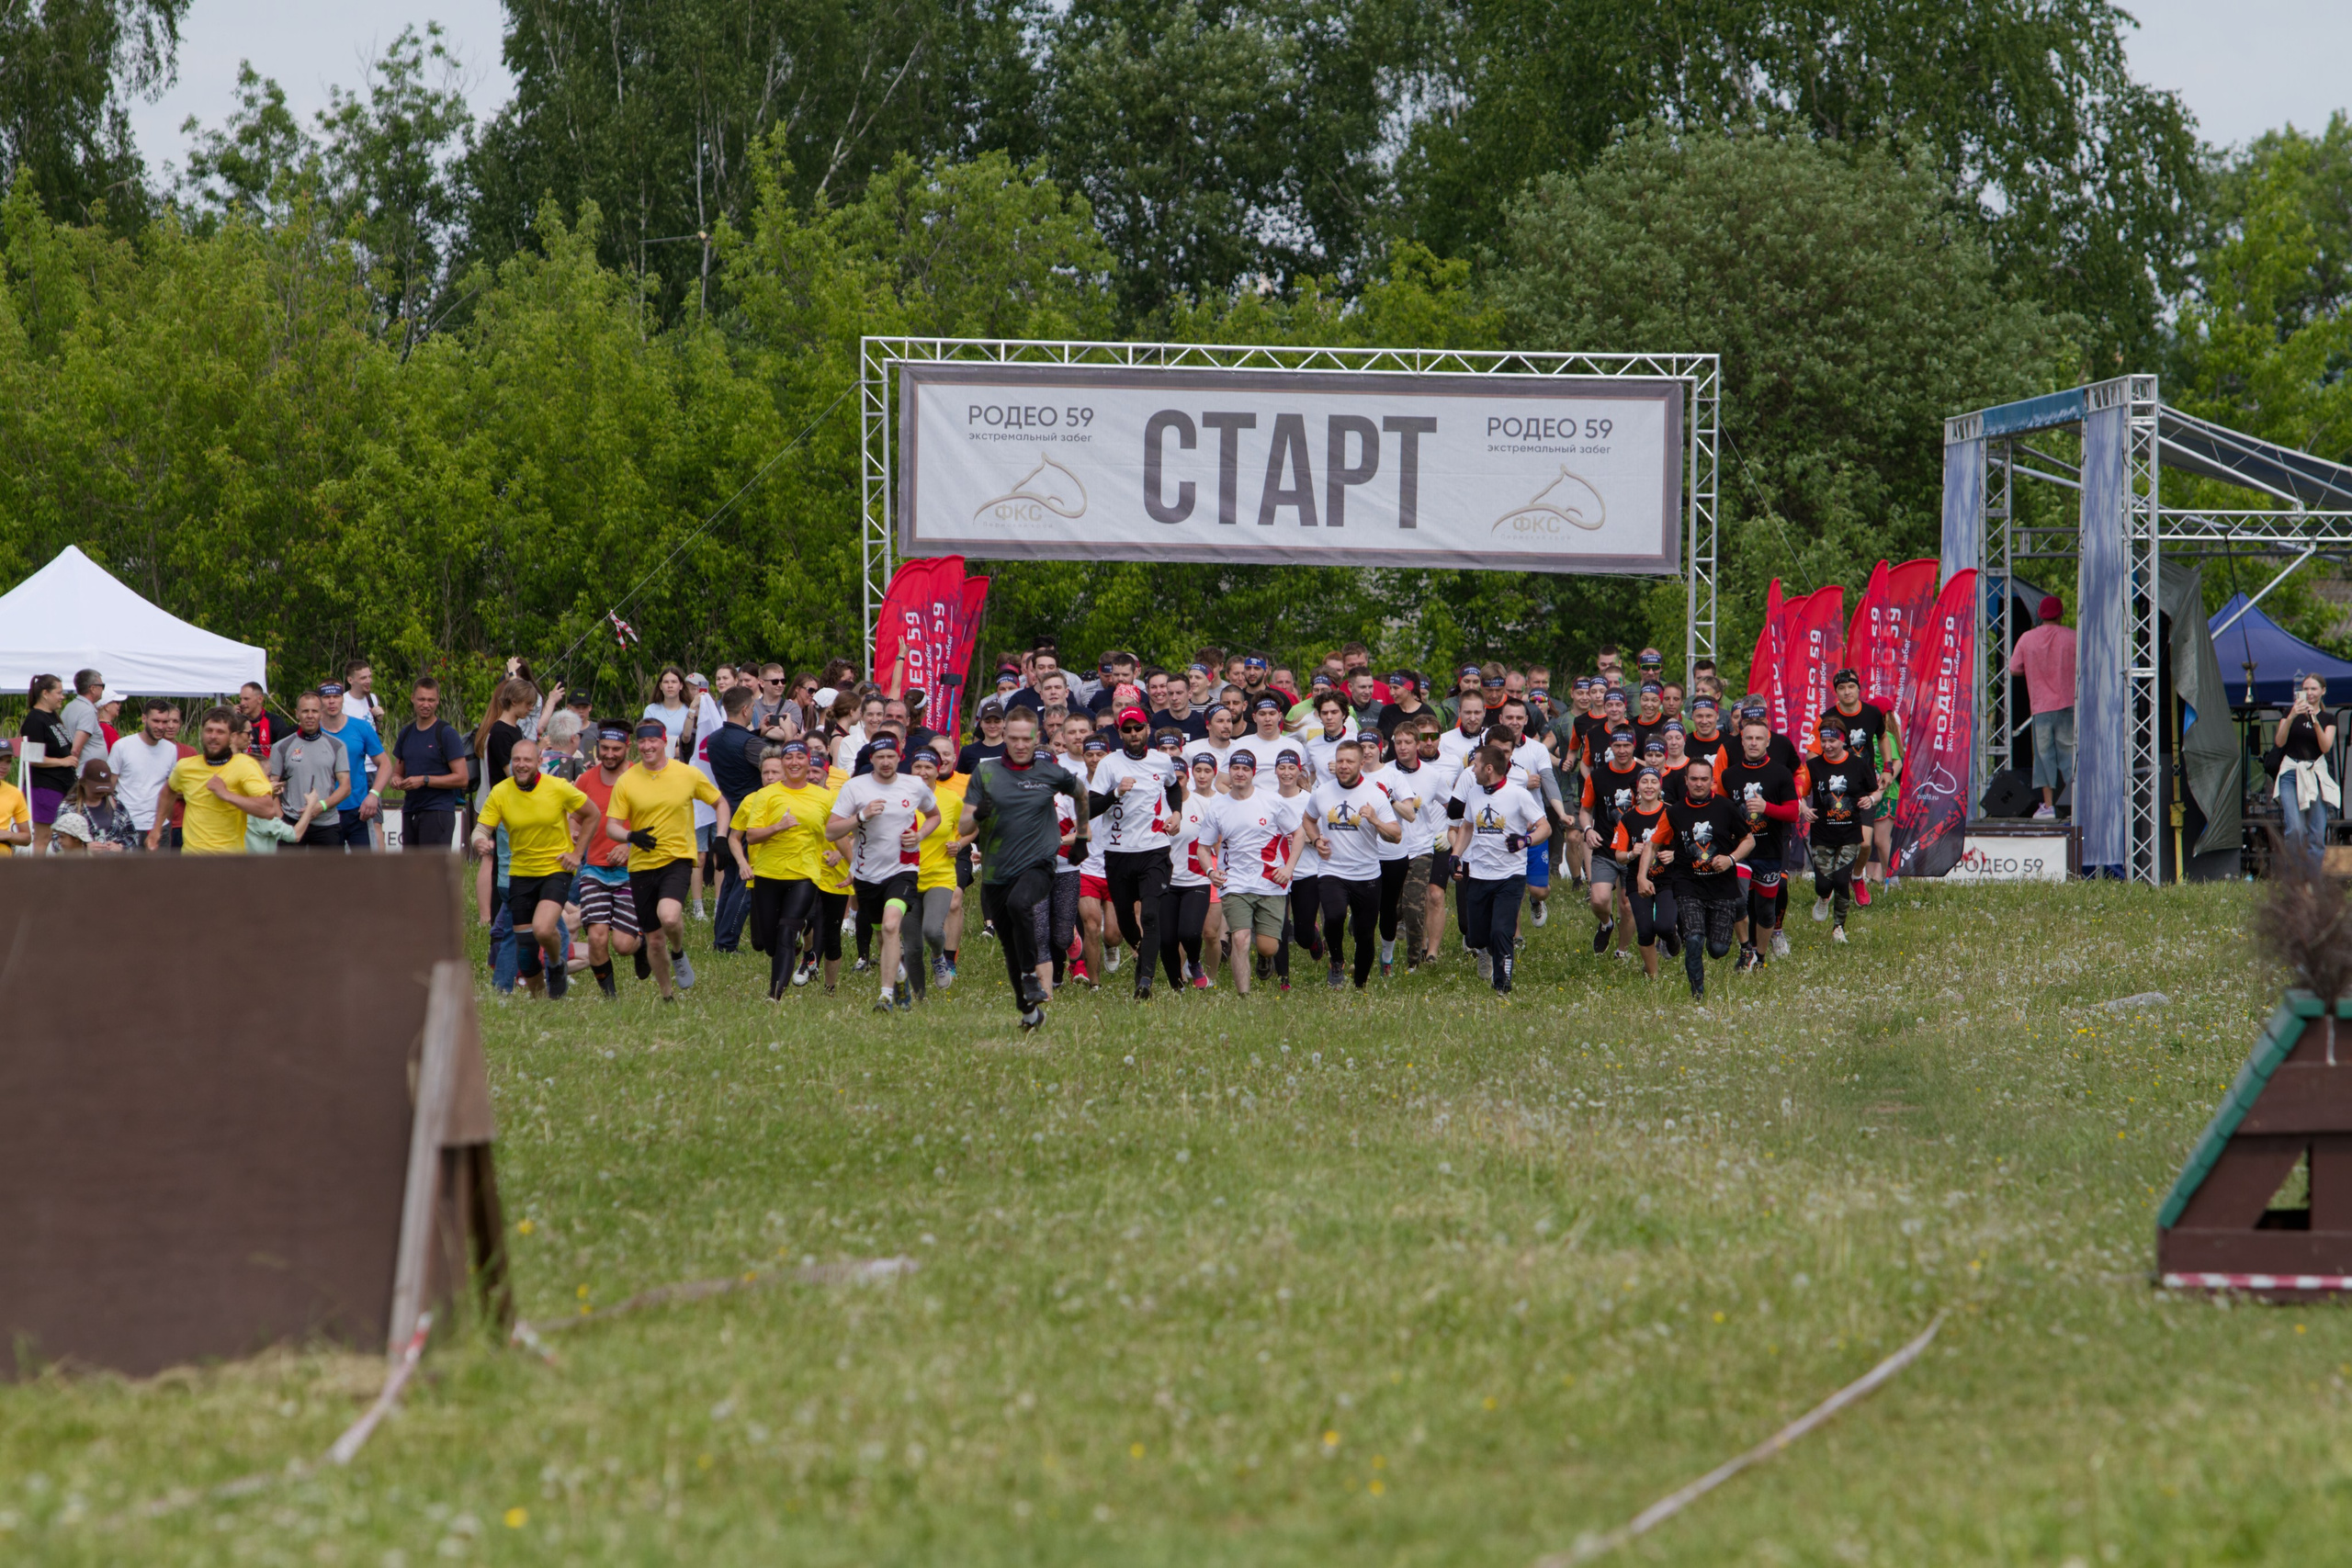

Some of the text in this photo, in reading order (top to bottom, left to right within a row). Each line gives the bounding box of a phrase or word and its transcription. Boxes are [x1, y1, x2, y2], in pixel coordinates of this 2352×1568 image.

[968, 405, 1094, 430] РОДЕО 59
[968, 432, 1092, 442] экстремальный забег
[1487, 416, 1613, 441] РОДЕО 59
[1487, 444, 1611, 454] экстремальный забег
[1144, 409, 1437, 529] СТАРТ
[994, 503, 1042, 522] ФКС
[1512, 515, 1560, 533] ФКС
[1809, 629, 1822, 660] 59
[1953, 858, 2044, 874] РОДЕО 59
